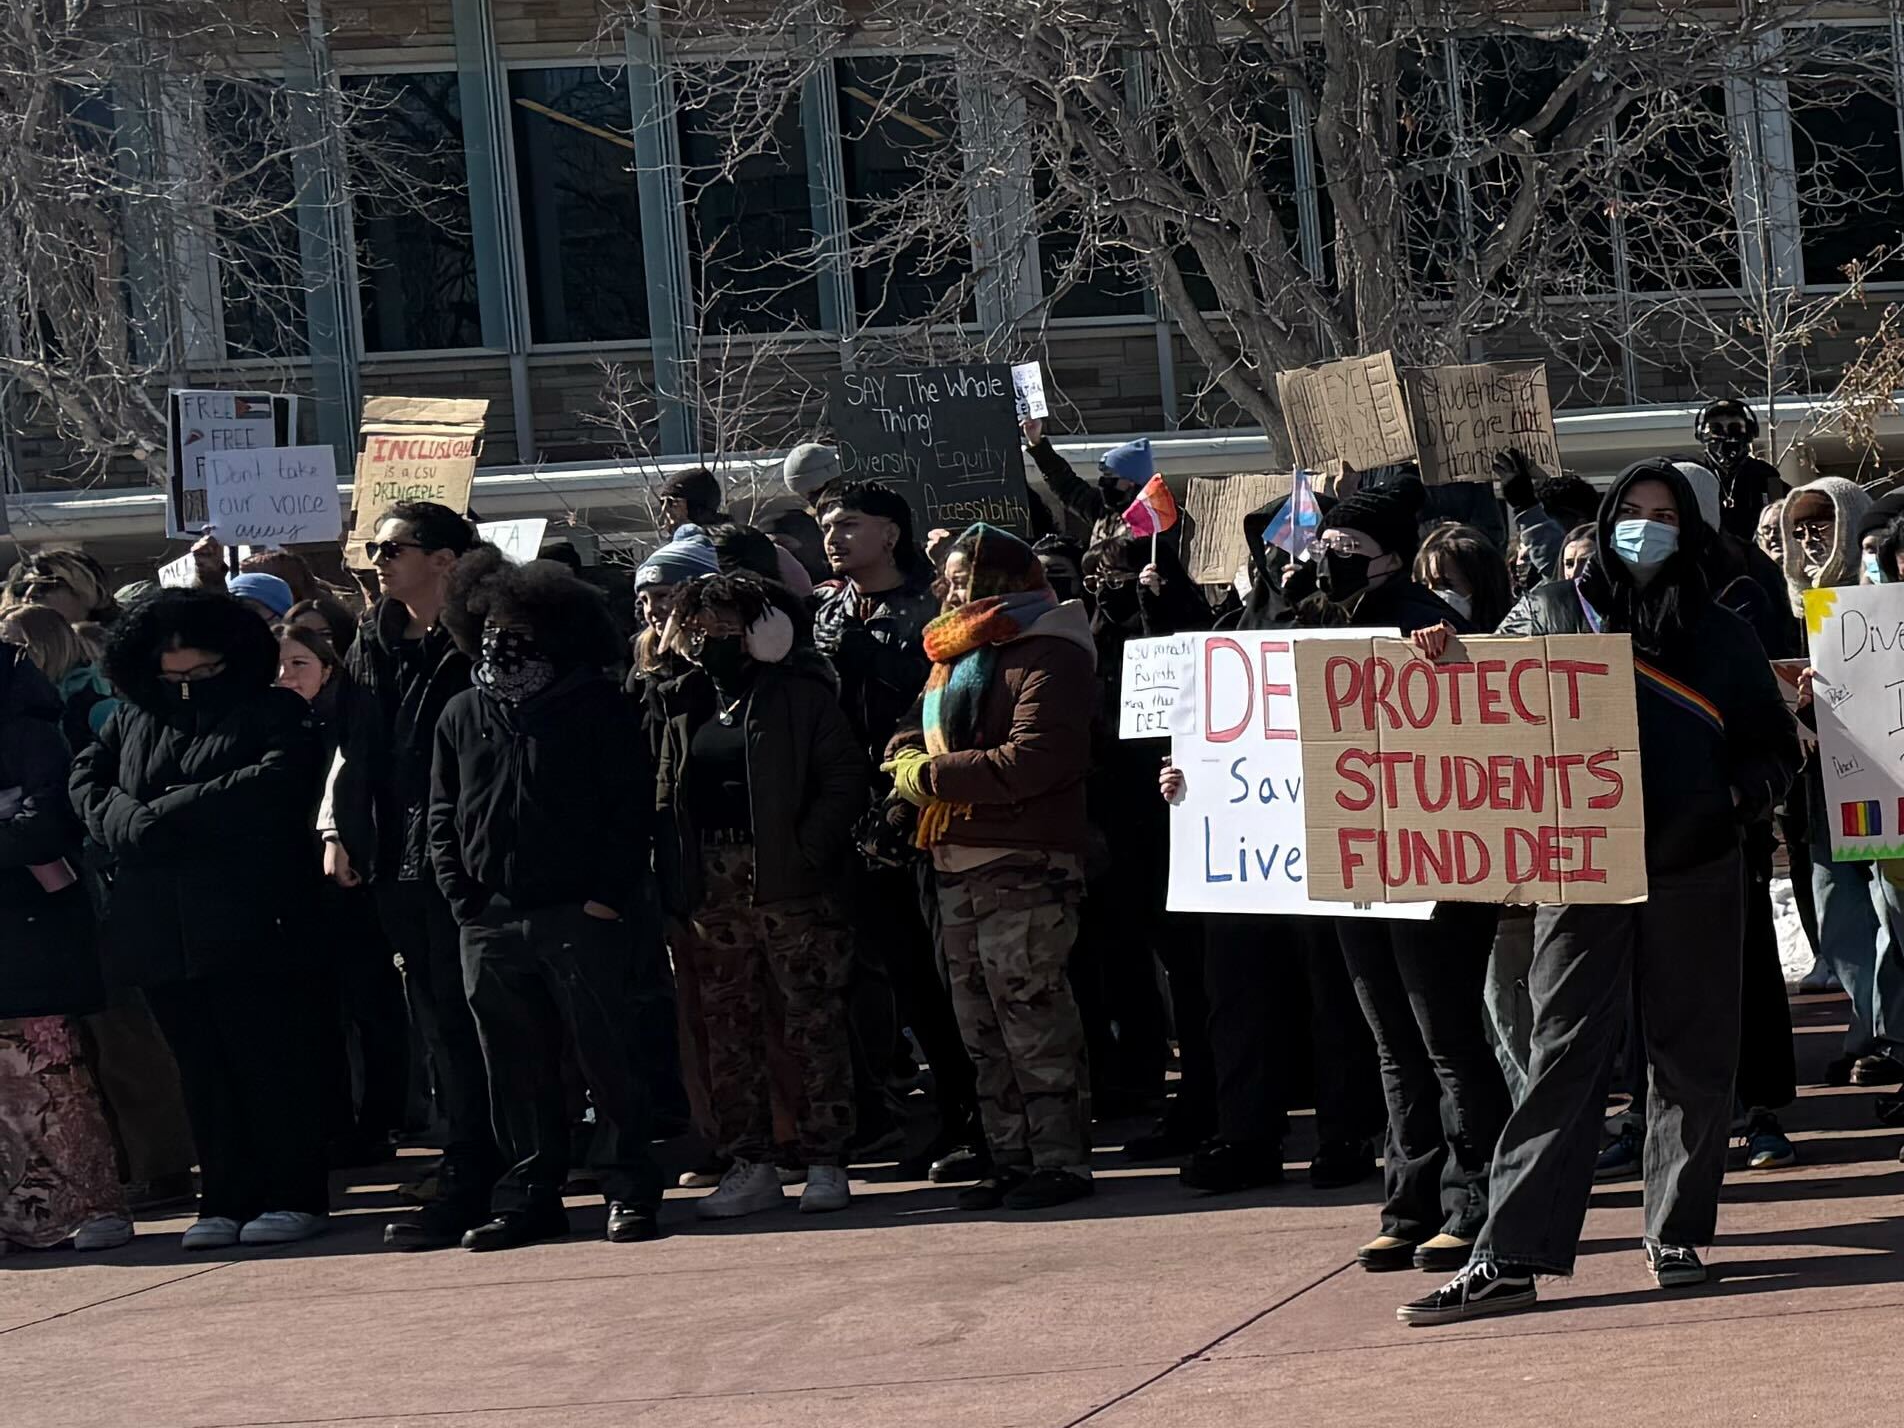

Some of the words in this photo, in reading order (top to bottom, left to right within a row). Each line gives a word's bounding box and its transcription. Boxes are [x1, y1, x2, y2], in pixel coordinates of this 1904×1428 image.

[844, 374, 886, 406] SAY
[895, 373, 940, 404] The
[944, 369, 1006, 398] Whole
[184, 396, 234, 420] FREE
[872, 405, 934, 447] Thing!
[1511, 408, 1543, 429] not
[211, 428, 258, 450] FREE
[372, 439, 475, 463] INCLUSION
[278, 456, 322, 480] take
[384, 465, 395, 479] is
[401, 468, 411, 478] a
[413, 466, 437, 479] CSU
[840, 441, 921, 482] Diversity
[934, 438, 1007, 484] Equity
[219, 496, 255, 516] our
[271, 495, 329, 516] voice
[372, 482, 446, 506] PRINCIPLE
[924, 483, 1031, 538] Accessibility
[1204, 636, 1297, 743] DE
[1325, 656, 1609, 733] PROTECT
[1136, 710, 1169, 732] DEI
[1229, 757, 1301, 804] Sav
[1335, 747, 1624, 813] STUDENTS
[1204, 816, 1302, 883] Live
[1338, 827, 1490, 890] FUND
[1505, 826, 1607, 884] DEI
